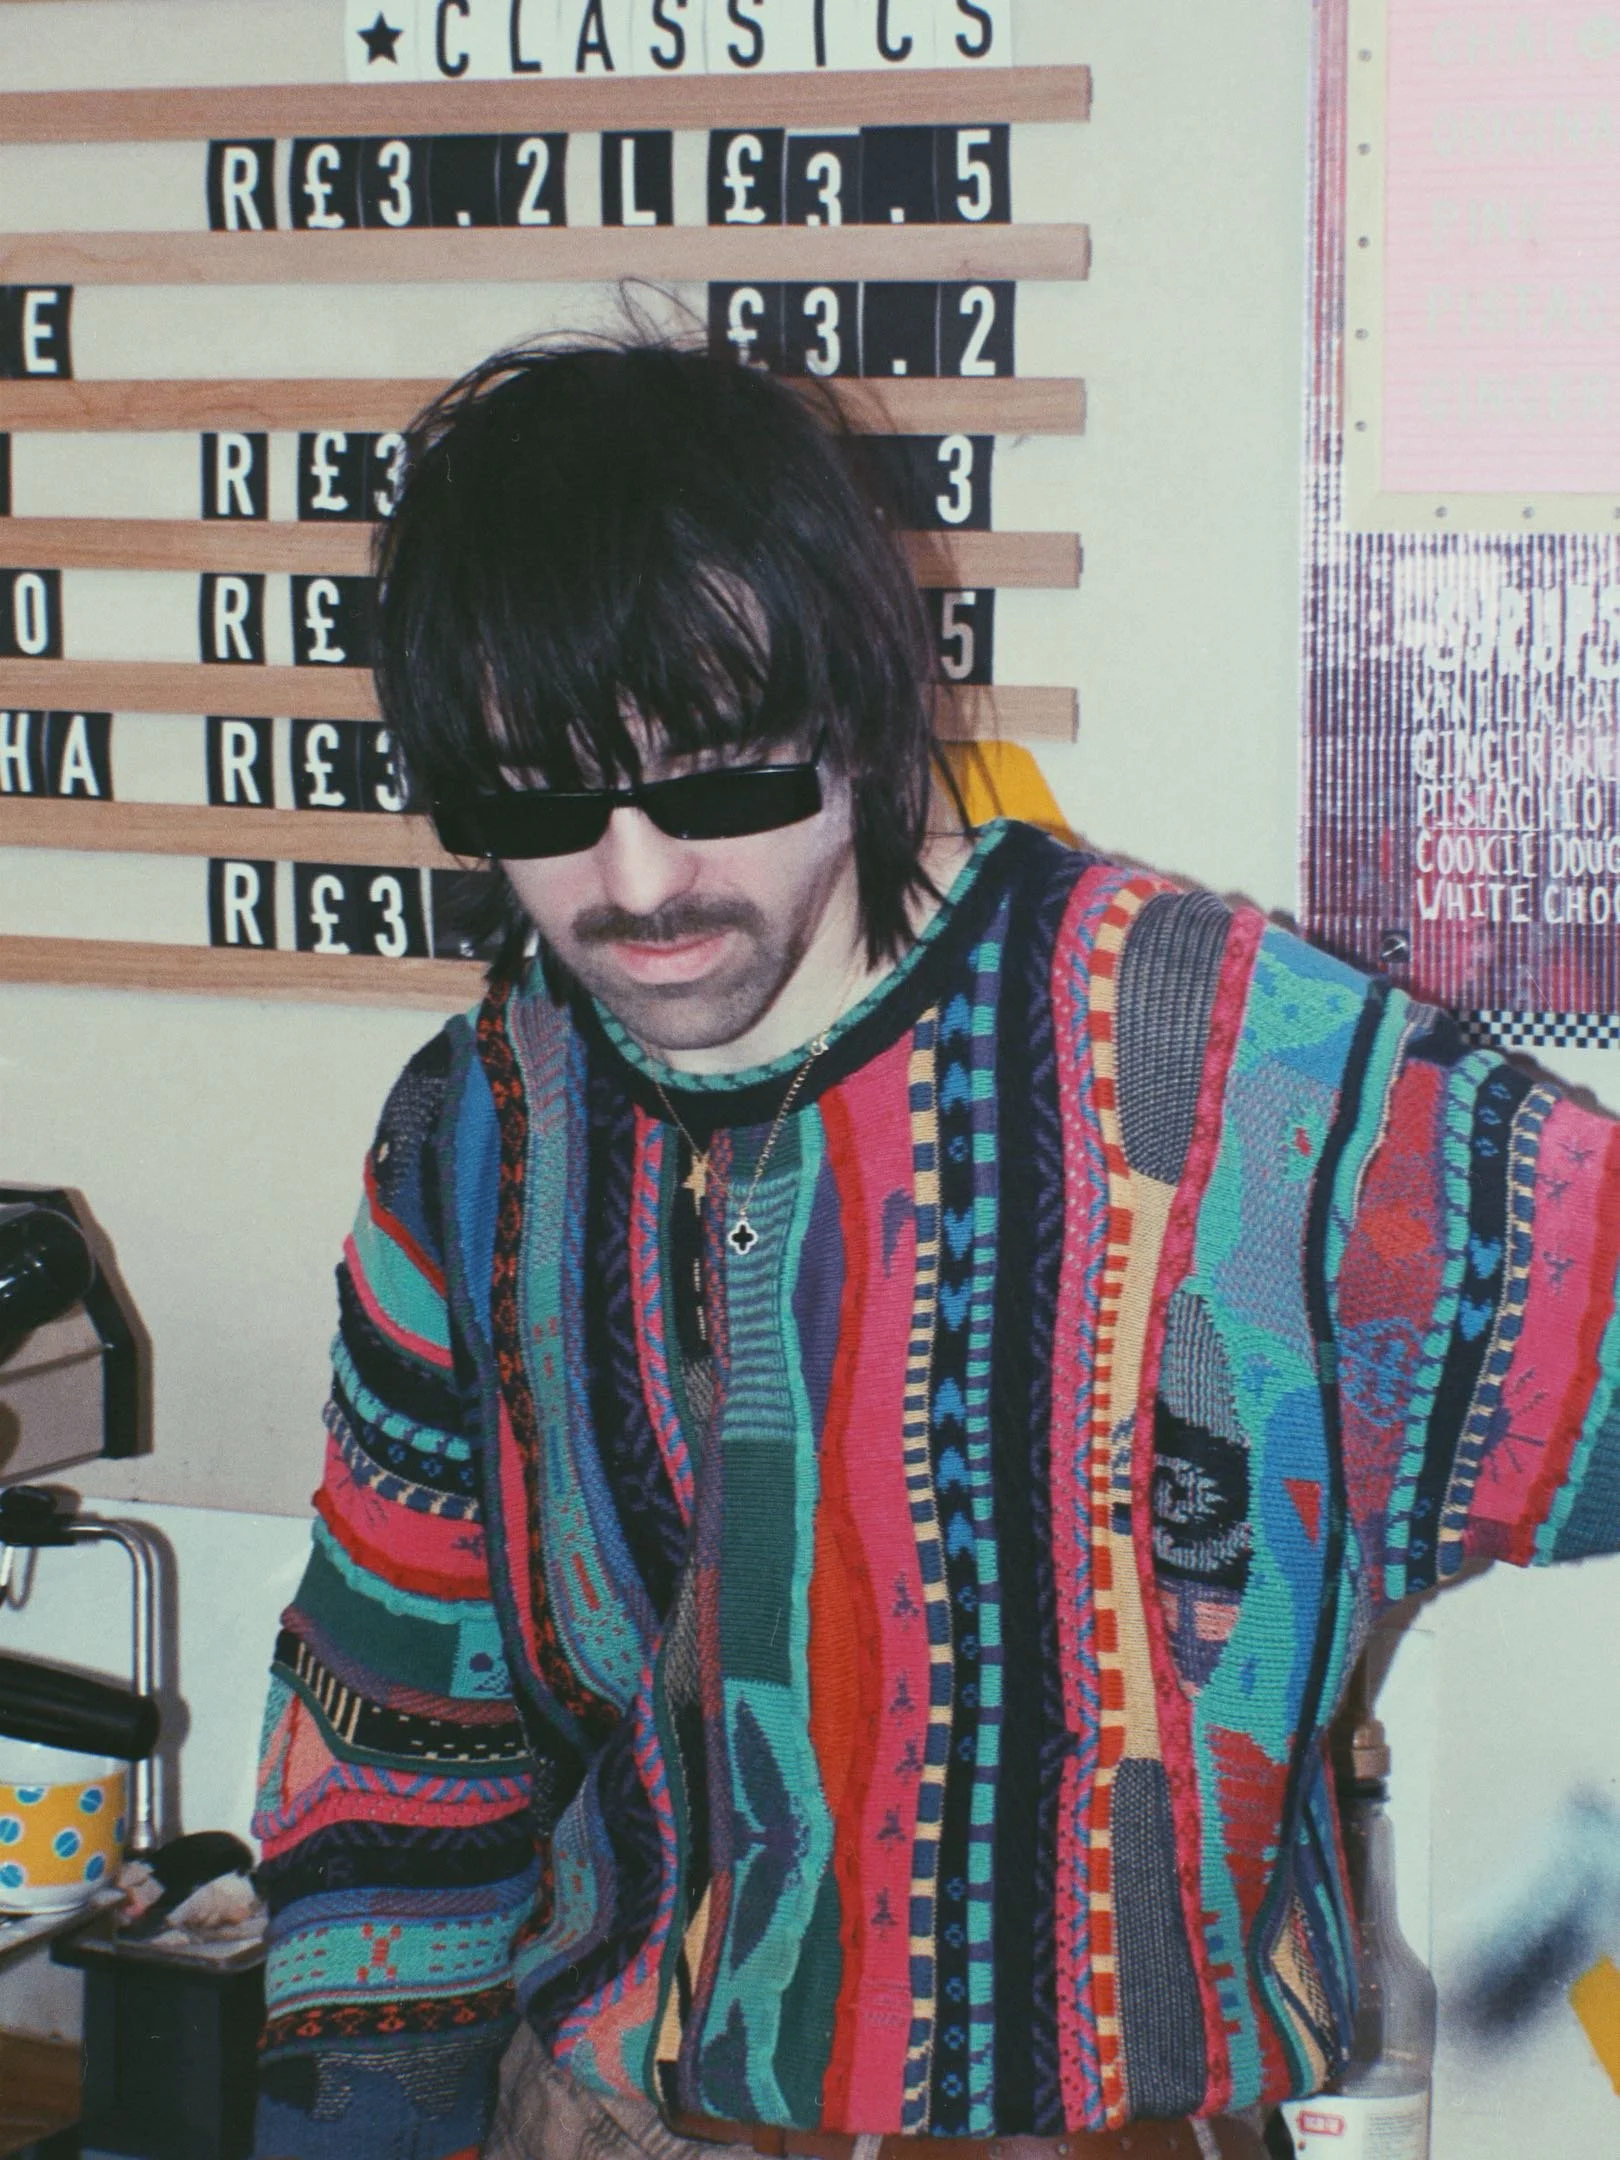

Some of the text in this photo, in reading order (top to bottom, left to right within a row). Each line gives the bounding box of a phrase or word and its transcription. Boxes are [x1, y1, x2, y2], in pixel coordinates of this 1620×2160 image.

[436, 0, 994, 78] CLASSICS
[223, 129, 993, 231] R £3.2 L £3.5
[23, 285, 996, 377] E £3.2
[217, 432, 255, 516] R
[214, 576, 253, 660] R
[221, 720, 262, 804] R
[1415, 830, 1539, 878] COOKIE
[223, 861, 263, 945] R
[1415, 878, 1533, 922] WHITE
